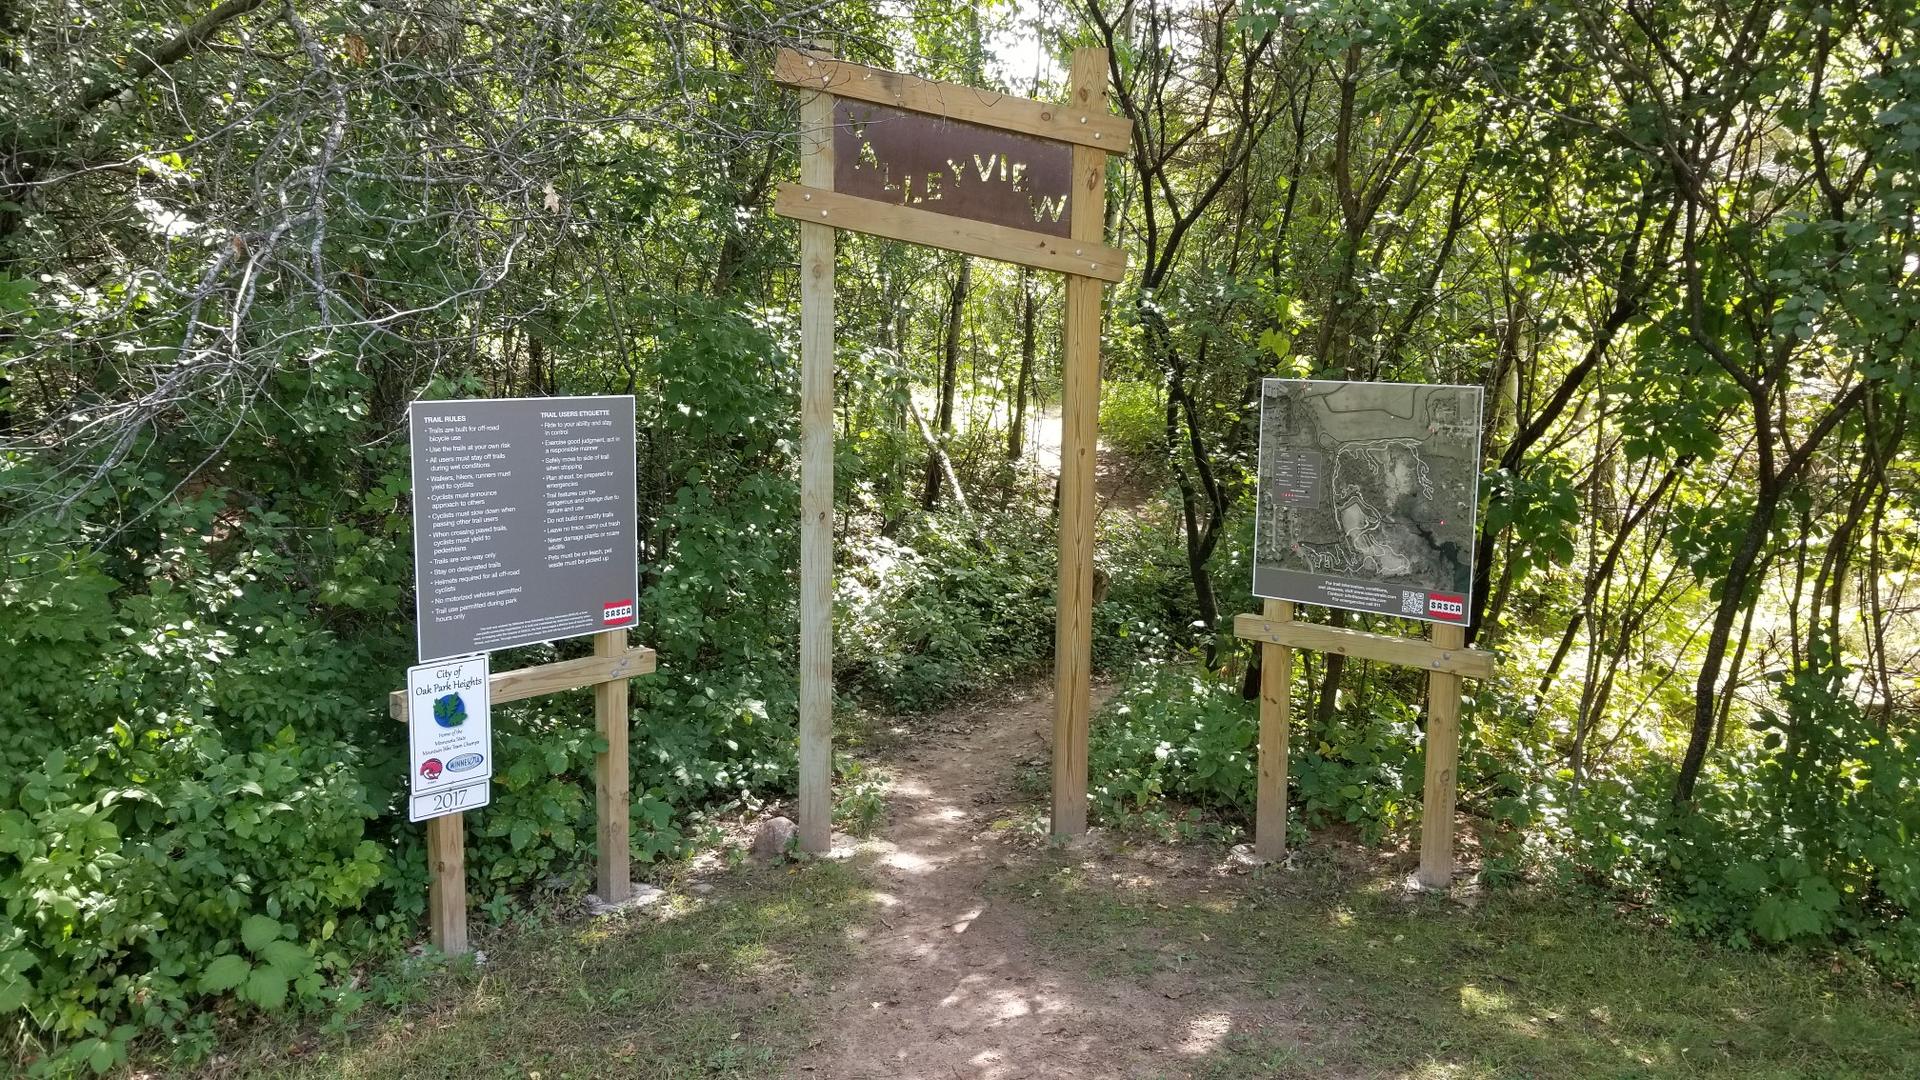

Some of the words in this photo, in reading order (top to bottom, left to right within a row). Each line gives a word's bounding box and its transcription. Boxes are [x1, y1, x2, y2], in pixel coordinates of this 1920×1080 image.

[431, 493, 453, 501] Cyclists
[546, 498, 573, 506] dangerous
[432, 501, 458, 509] approach
[432, 512, 454, 520] Cyclists
[433, 520, 454, 528] passing
[450, 528, 474, 537] crossing
[433, 538, 454, 547] cyclists
[434, 545, 466, 555] pedestrians
[456, 563, 486, 573] designated
[434, 577, 457, 585] Helmets
[458, 574, 481, 583] required
[434, 586, 455, 594] cyclists
[444, 593, 472, 602] motorized
[496, 586, 521, 596] permitted
[459, 602, 485, 611] permitted
[487, 599, 504, 608] during
[1431, 602, 1461, 612] SASCA
[605, 607, 631, 618] SASCA
[436, 670, 452, 680] City
[454, 666, 463, 678] of
[416, 684, 432, 696] Oak
[434, 681, 451, 692] Park
[454, 676, 482, 690] Heights
[450, 756, 480, 768] MINNESOTA
[434, 790, 467, 811] 2017
